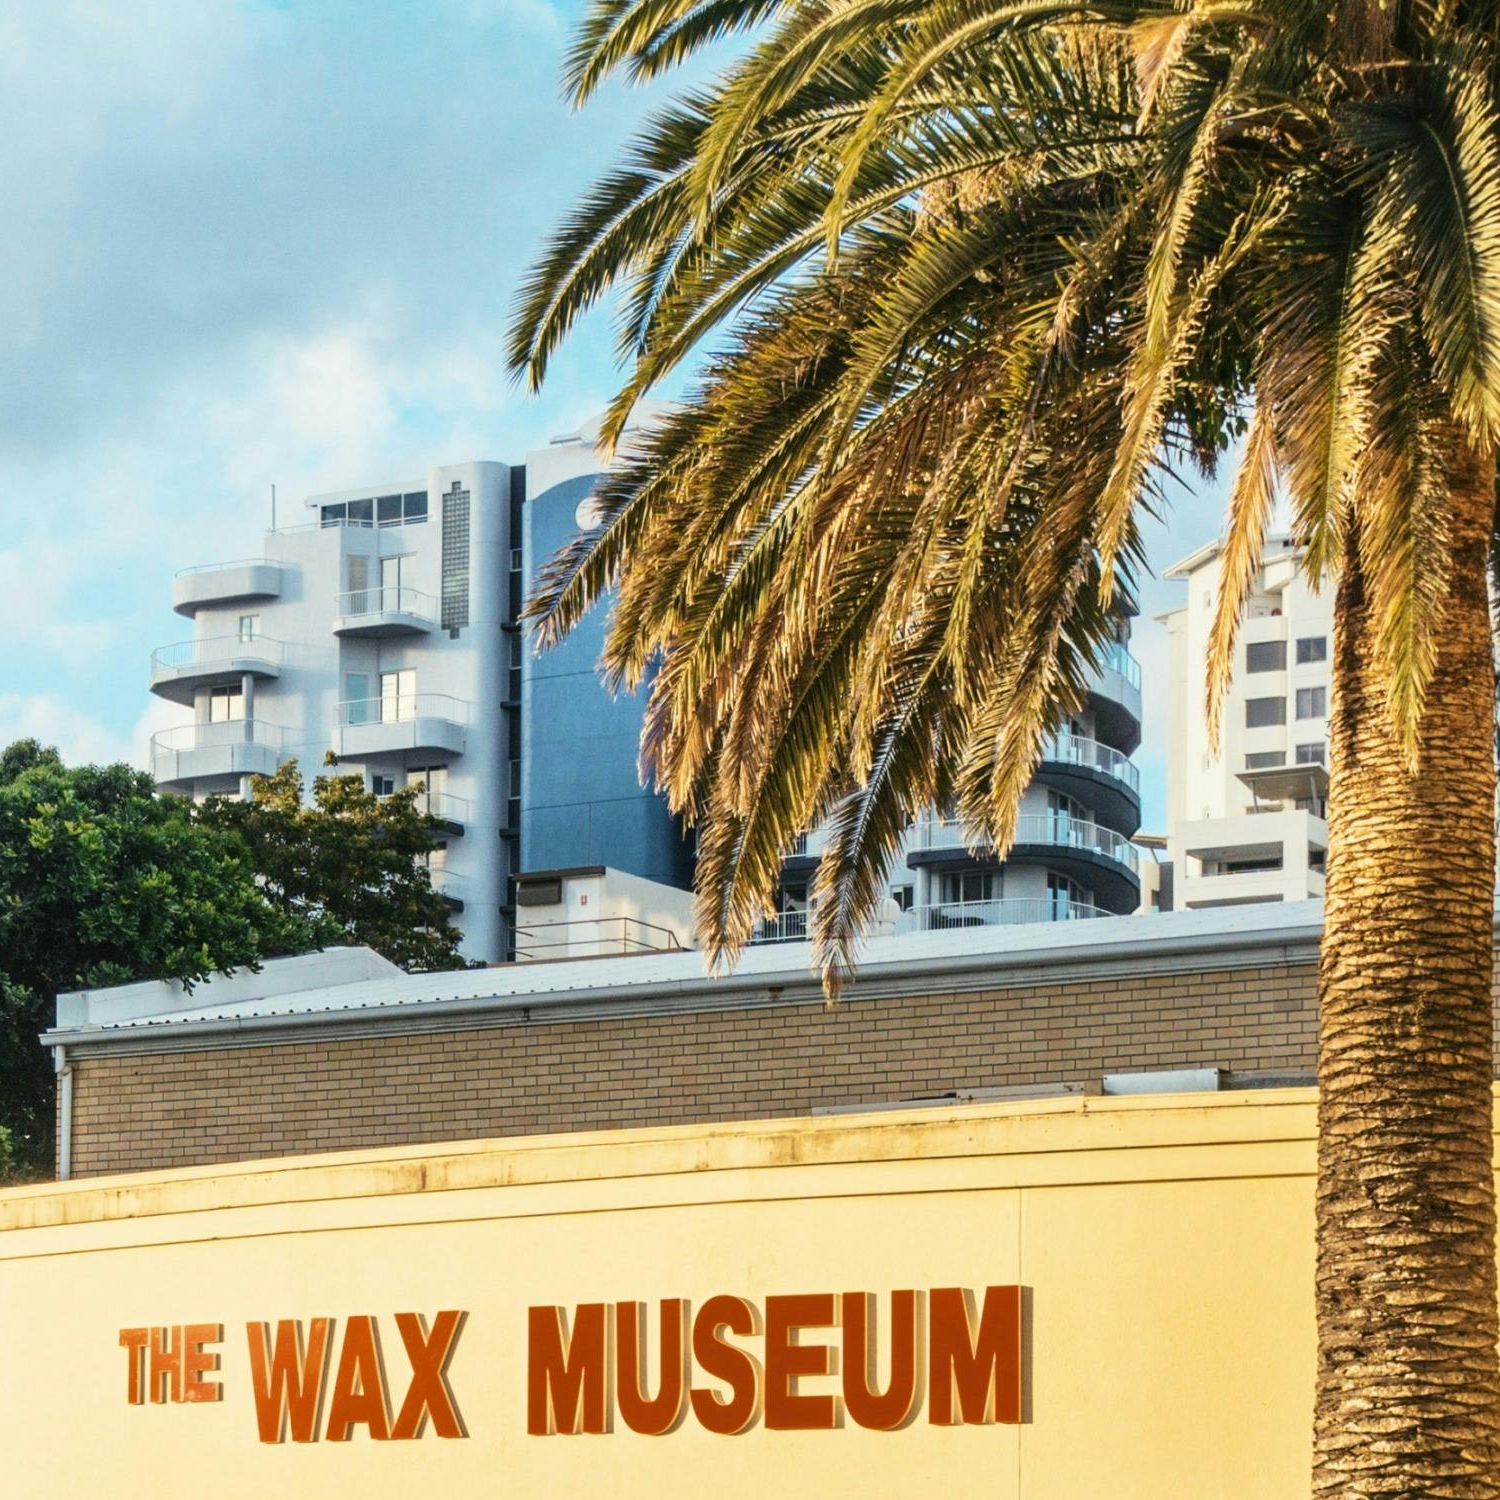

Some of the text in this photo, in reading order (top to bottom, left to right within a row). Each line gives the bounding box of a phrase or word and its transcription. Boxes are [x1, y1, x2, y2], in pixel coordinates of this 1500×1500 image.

[118, 1285, 1033, 1444] THE WAX MUSEUM
